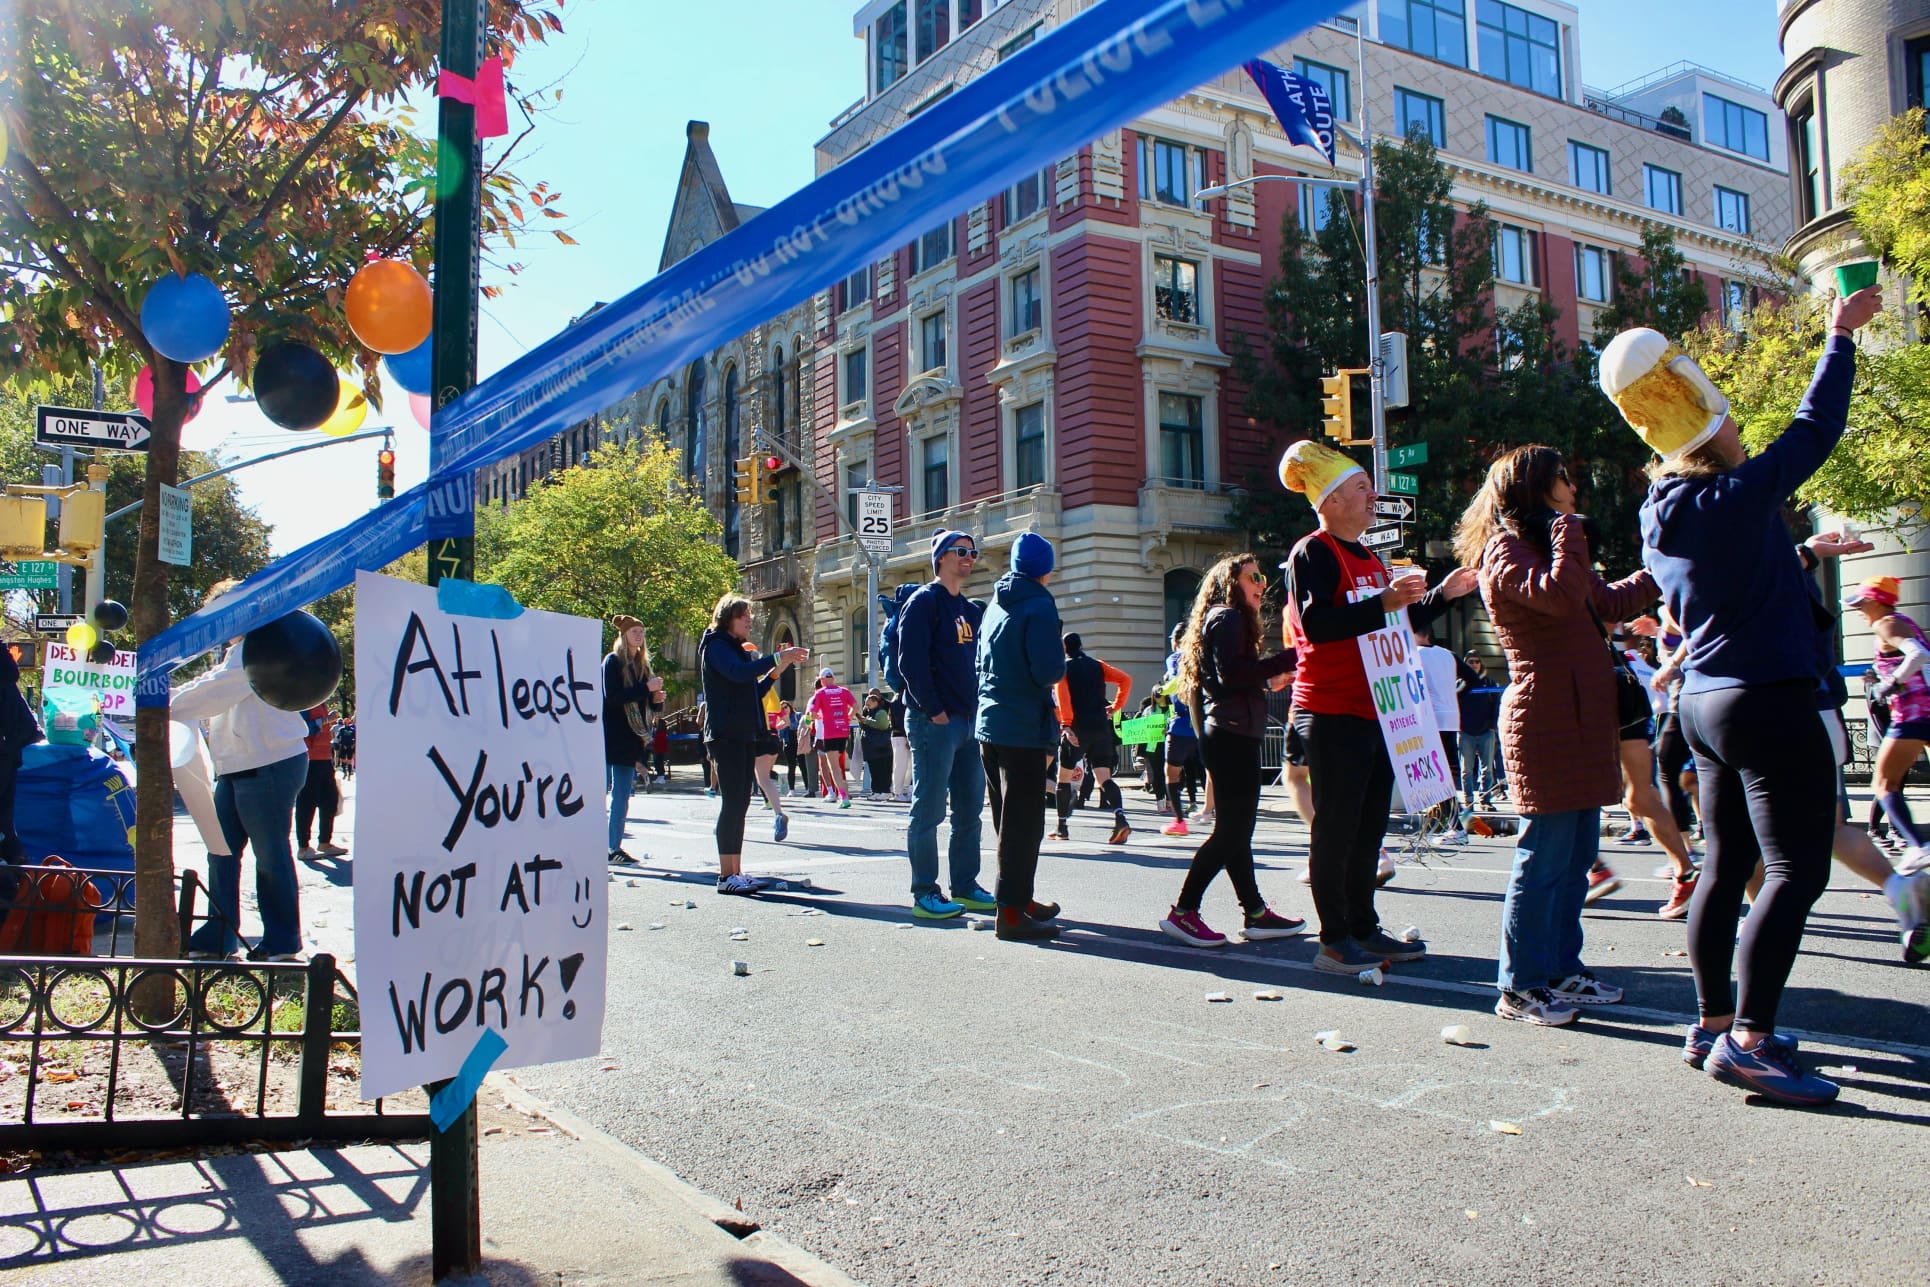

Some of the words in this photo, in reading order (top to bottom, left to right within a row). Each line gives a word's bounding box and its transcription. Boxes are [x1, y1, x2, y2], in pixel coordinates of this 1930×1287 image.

[1309, 86, 1333, 155] OUTE
[55, 419, 90, 436] ONE
[106, 423, 141, 440] WAY
[1399, 449, 1405, 465] 5
[1398, 474, 1409, 491] 127
[1374, 502, 1385, 513] NE
[1391, 503, 1408, 514] WAY
[863, 516, 889, 534] 25
[1380, 531, 1396, 542] WAY
[22, 562, 29, 573] E
[31, 562, 46, 573] 127
[27, 576, 52, 586] Hughes
[41, 620, 57, 628] ONE
[50, 645, 77, 662] DES
[1367, 629, 1413, 668] TOO!
[53, 668, 138, 691] BOURBON
[390, 611, 482, 718] At
[490, 629, 598, 730] least
[1373, 675, 1405, 716] OUT
[1406, 669, 1425, 705] OF
[1389, 713, 1418, 733] PATIENCE
[427, 745, 585, 853] You're
[392, 863, 477, 938] NOT
[500, 854, 563, 914] AT
[389, 952, 585, 1055] WORK!
